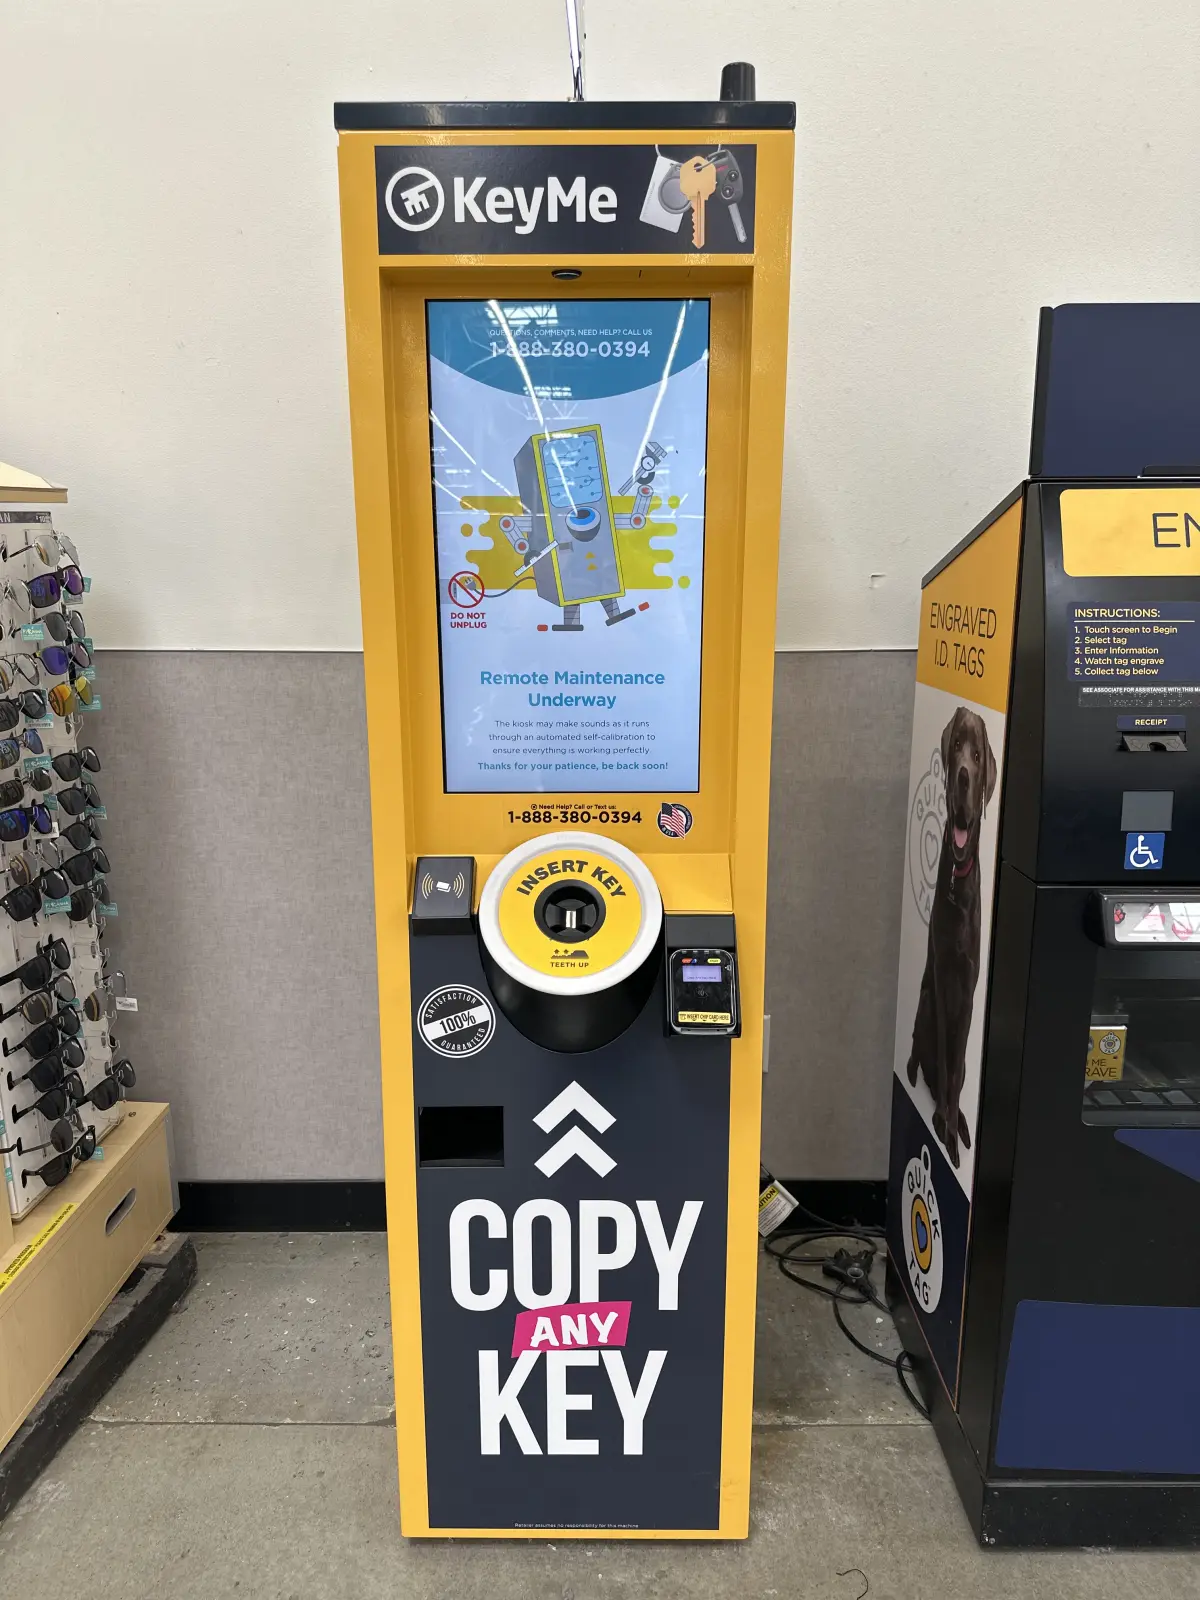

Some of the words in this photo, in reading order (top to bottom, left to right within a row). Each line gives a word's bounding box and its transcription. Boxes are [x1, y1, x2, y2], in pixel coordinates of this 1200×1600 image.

[453, 176, 618, 235] KeyMe
[489, 329, 533, 337] QUETIONS,
[534, 329, 577, 337] COMMENTS,
[489, 341, 650, 357] 1-888-380-0394
[450, 612, 464, 620] DO
[466, 612, 485, 620] NOT
[930, 602, 997, 639] ENGRAVED
[1074, 608, 1160, 618] INSTRUCTIONS:
[450, 621, 487, 629] UNPLUG
[1074, 626, 1080, 634] 1.
[1084, 626, 1110, 634] Touch
[1112, 626, 1140, 634] screen
[1142, 626, 1151, 634] to
[1153, 626, 1178, 635] Begin
[1074, 636, 1082, 644] 2.
[1084, 636, 1111, 644] Select
[1113, 637, 1127, 645] tag
[934, 639, 949, 669] I.D.
[953, 642, 985, 679] TAGS
[1074, 657, 1082, 665] 4.
[1084, 657, 1112, 665] Watch
[1114, 657, 1128, 666] tag
[1130, 658, 1165, 666] engrave
[480, 671, 549, 685] Remote
[554, 671, 666, 685] Maintenance
[1074, 667, 1082, 675] 5.
[1084, 667, 1115, 675] Collect
[1116, 668, 1131, 676] tag
[1133, 667, 1159, 675] below
[528, 693, 617, 709] Underway
[494, 720, 510, 728] The
[512, 720, 534, 728] kiosk
[536, 721, 553, 729] may
[555, 720, 579, 728] make
[581, 720, 610, 728] sounds
[623, 720, 629, 728] it
[1134, 718, 1168, 726] RECEIPT
[489, 733, 522, 742] through
[536, 733, 581, 741] automated
[583, 733, 645, 741] self-calibration
[647, 733, 656, 741] to
[522, 747, 566, 755] everything
[577, 747, 610, 755] working
[478, 762, 512, 770] Thanks
[514, 762, 528, 770] for
[531, 763, 552, 772] your
[555, 762, 599, 772] patience,
[602, 762, 614, 770] be
[616, 762, 640, 770] back
[642, 762, 668, 770] soon!
[917, 783, 947, 824] QUIC
[507, 811, 643, 823] 1-888-380-0394
[516, 859, 589, 896] INSERT
[591, 866, 627, 897] KEY
[919, 880, 931, 913] TA
[425, 992, 478, 1019] SATISFACTION
[439, 1011, 477, 1034] 100%
[441, 1027, 486, 1051] GUARANTEED
[1091, 1058, 1107, 1067] ME
[907, 1165, 940, 1241] QUICK
[449, 1198, 704, 1312] COPY
[909, 1250, 929, 1305] TAG
[529, 1311, 619, 1348] ANY
[478, 1350, 668, 1455] KEY
